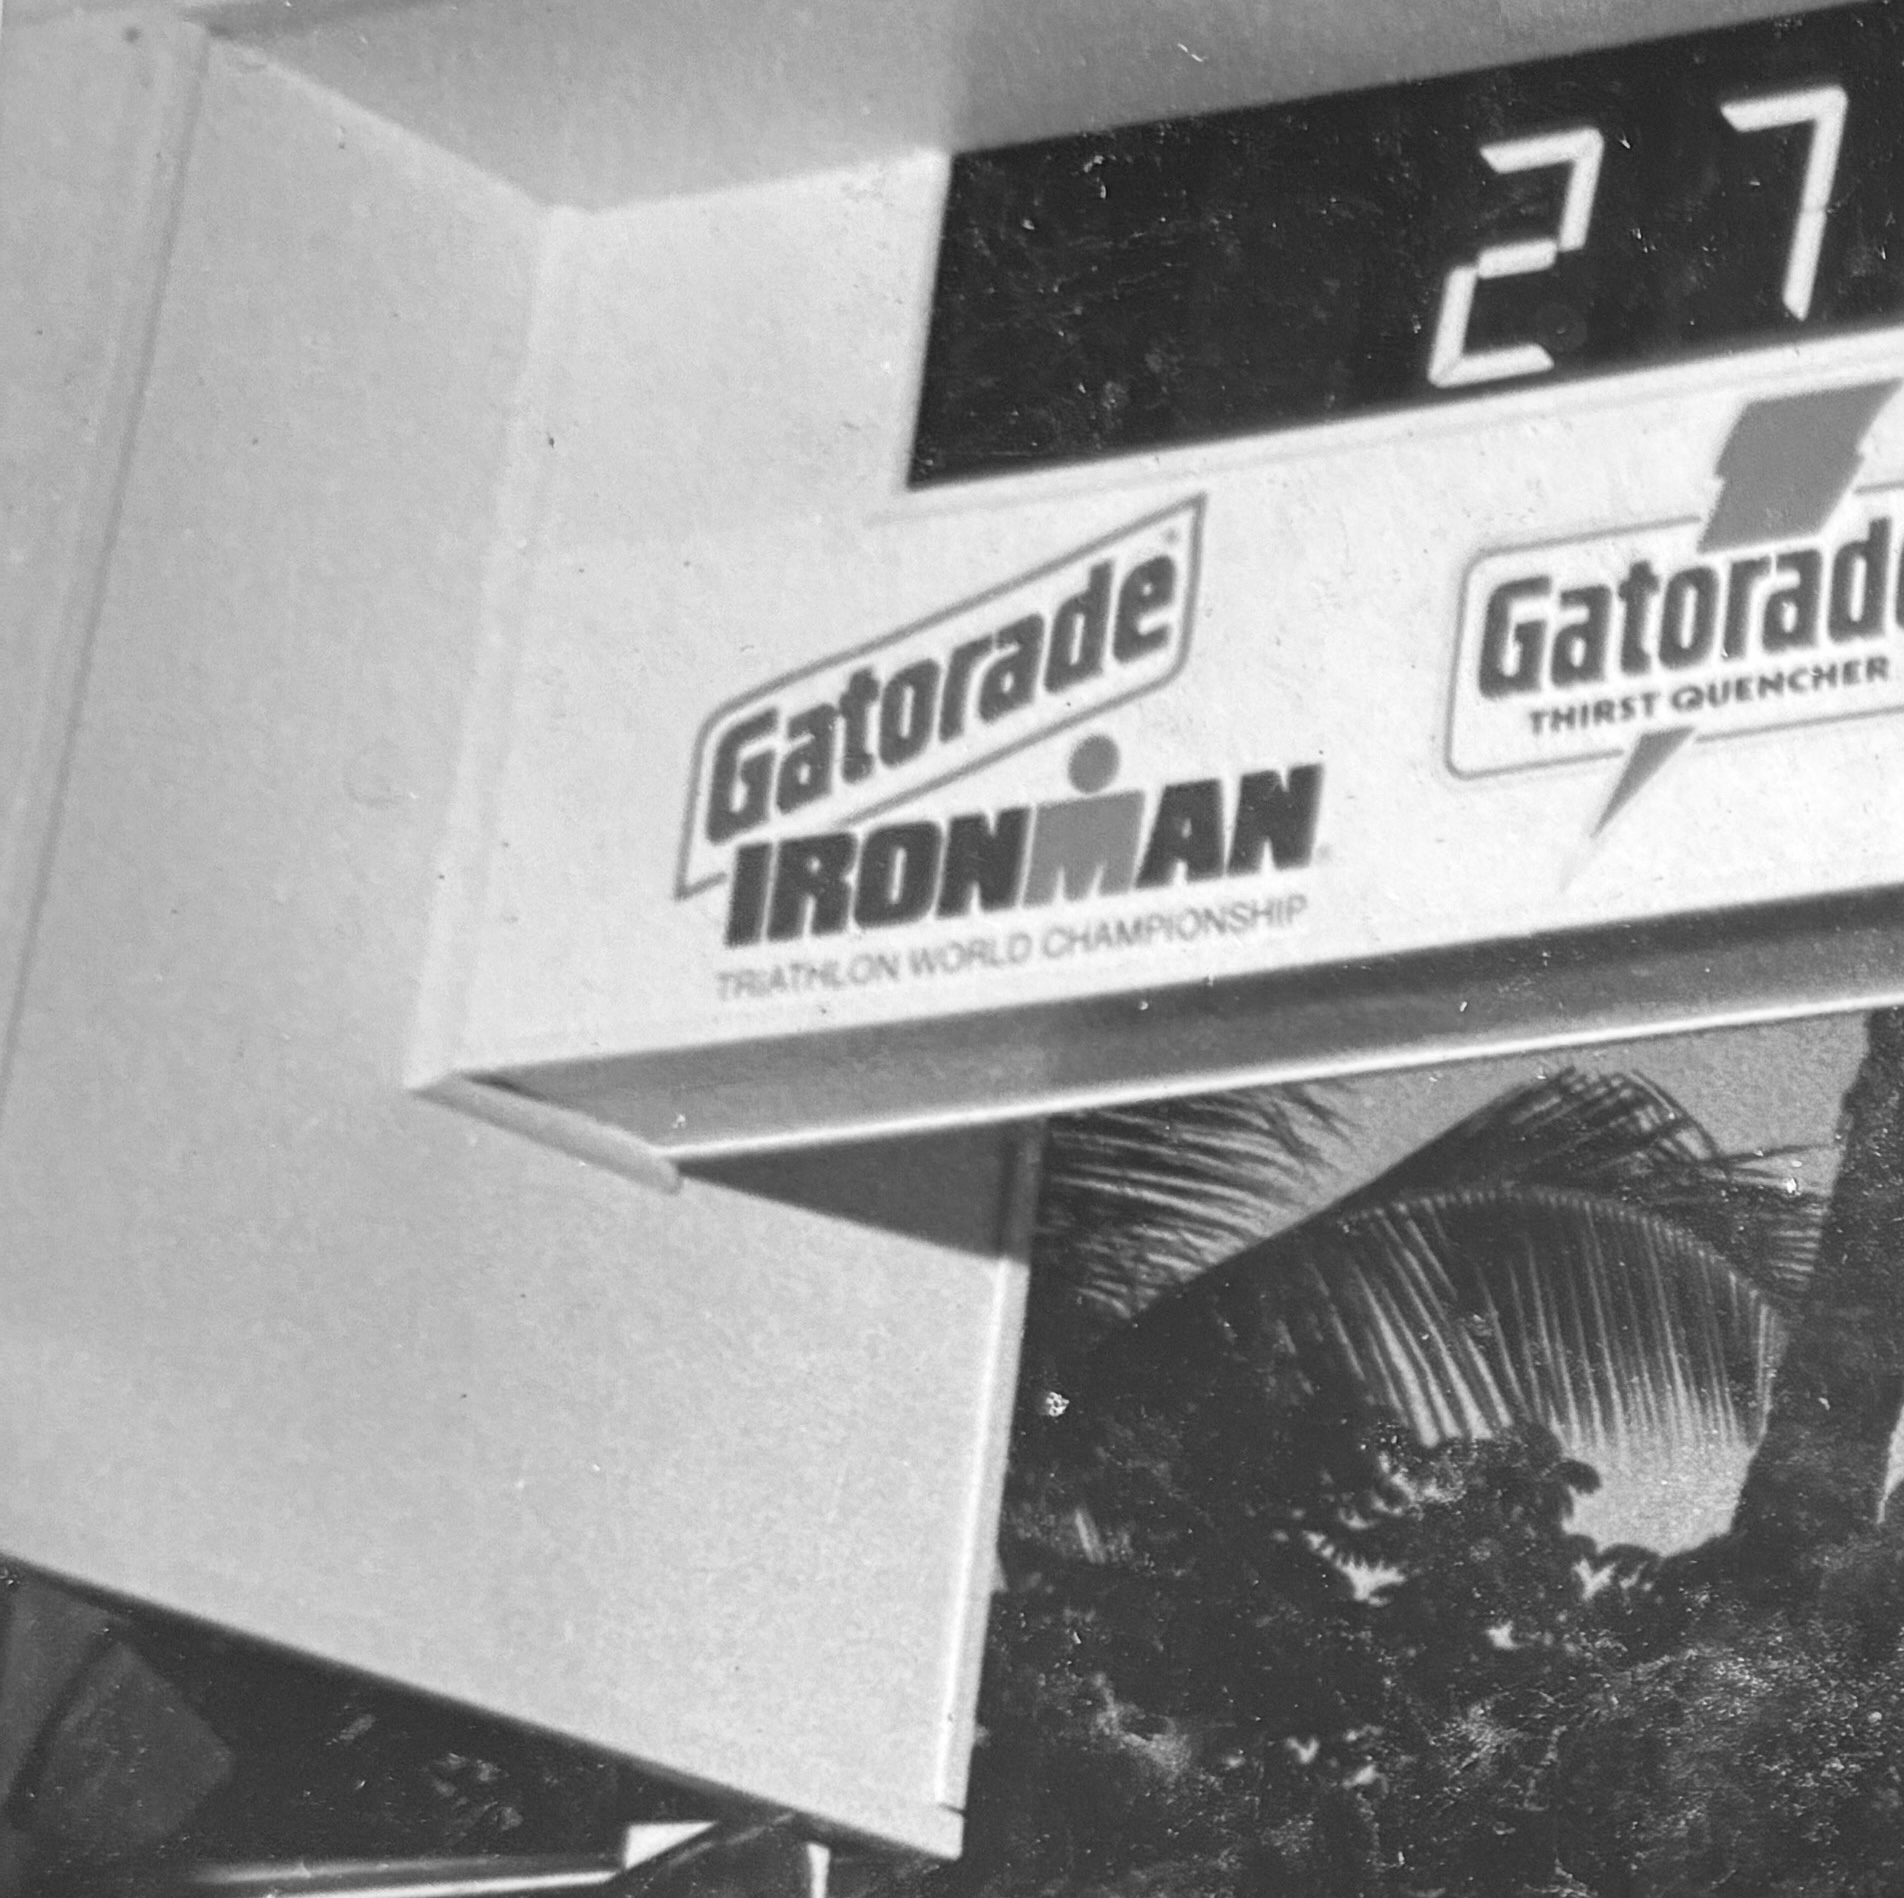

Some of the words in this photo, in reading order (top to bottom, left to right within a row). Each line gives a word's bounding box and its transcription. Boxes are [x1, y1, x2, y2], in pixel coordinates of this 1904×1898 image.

[704, 553, 1177, 845] Gatorade
[1529, 690, 1662, 736] THIRST
[1670, 655, 1892, 712] QUENCHER
[723, 734, 1325, 949] IRONMAN
[717, 950, 900, 1000] TRIATHLON
[908, 932, 1033, 975] WORLD
[1041, 893, 1310, 958] CHAMPIONSHIP
